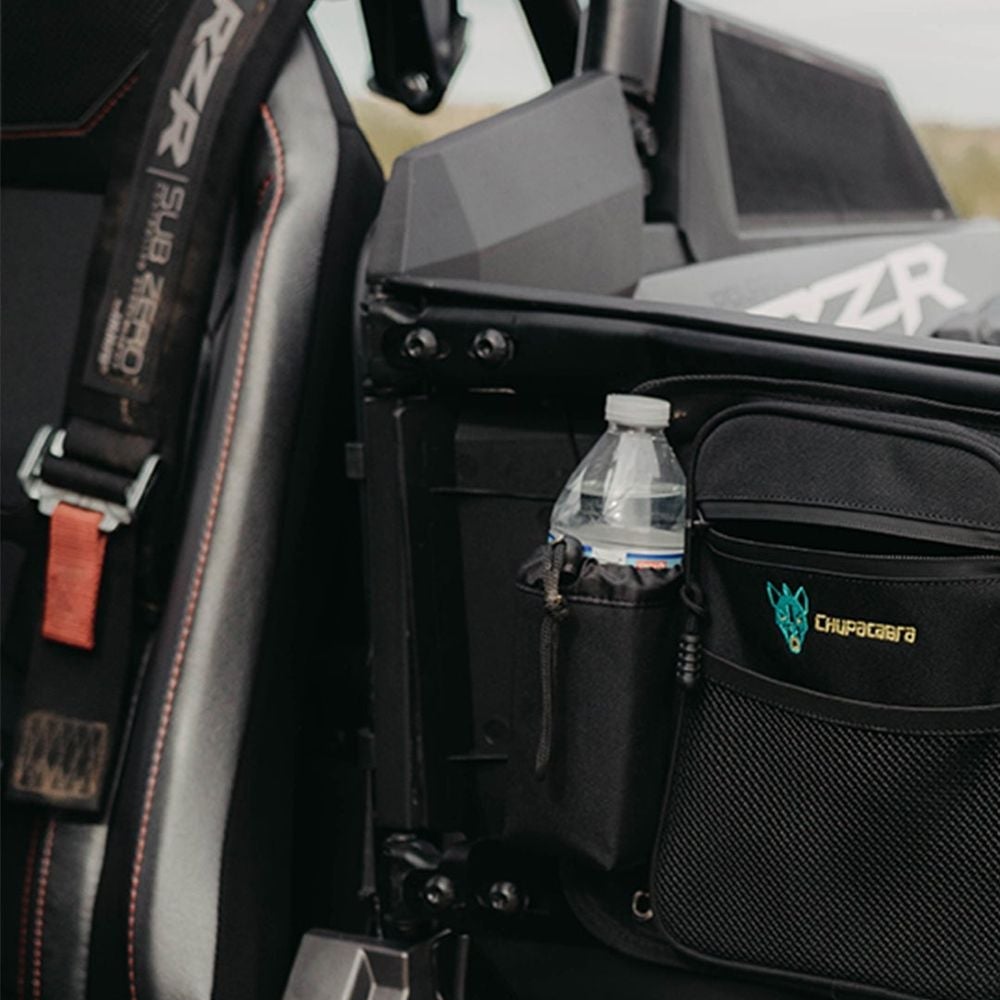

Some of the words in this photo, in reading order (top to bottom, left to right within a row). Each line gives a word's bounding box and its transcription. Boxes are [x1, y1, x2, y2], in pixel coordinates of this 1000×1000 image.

[156, 0, 244, 168] RZR
[149, 184, 187, 265] SUB
[120, 271, 165, 376] ZERO
